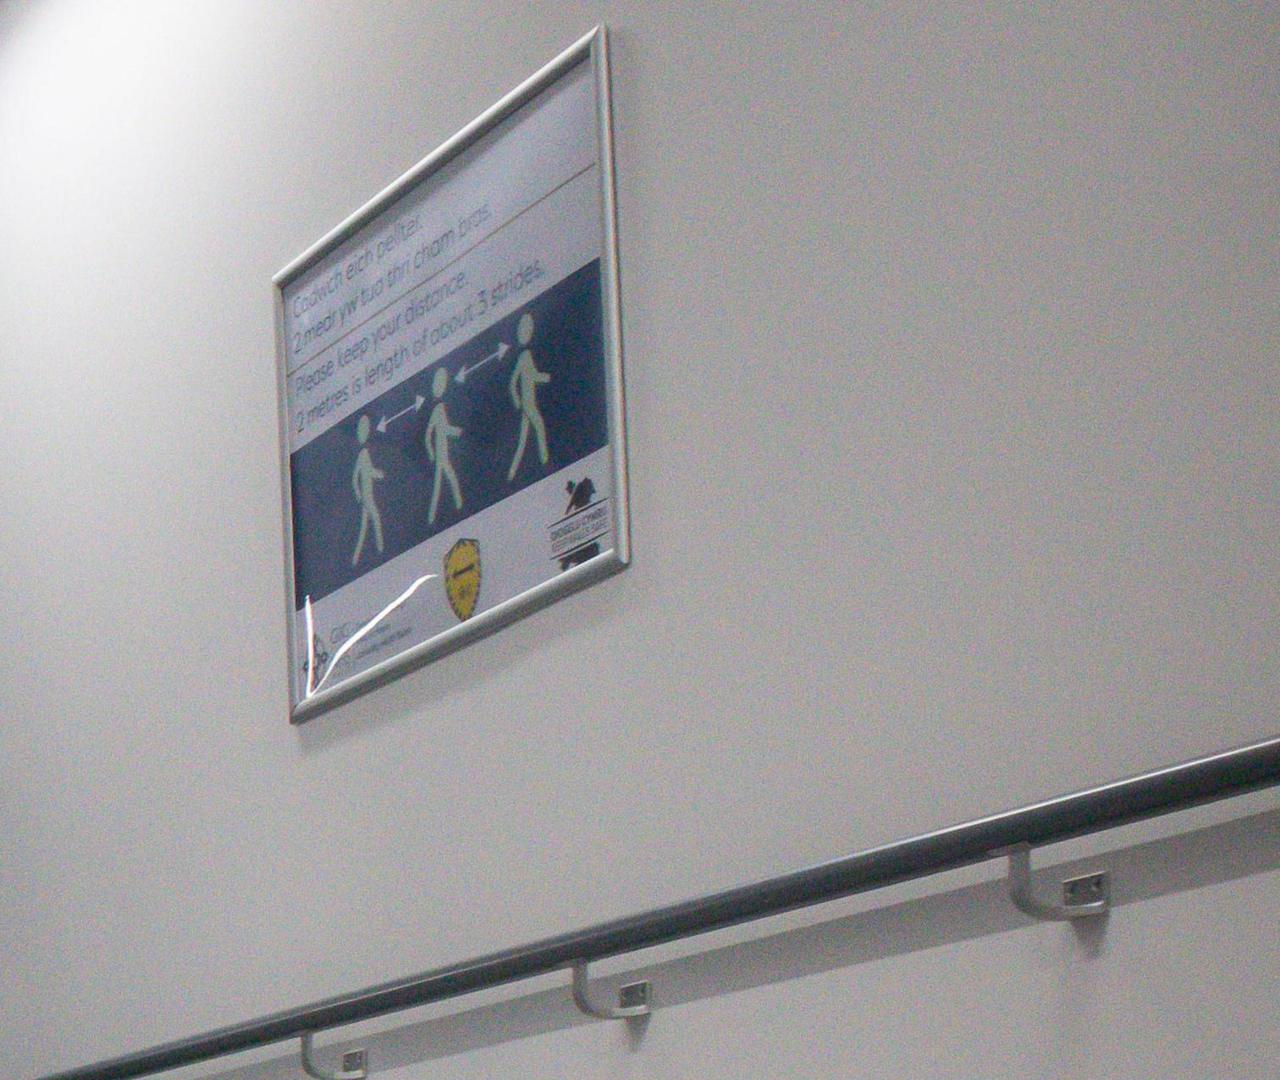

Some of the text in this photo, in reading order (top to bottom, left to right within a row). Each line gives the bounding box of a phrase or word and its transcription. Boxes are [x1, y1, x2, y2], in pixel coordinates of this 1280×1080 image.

[345, 246, 373, 279] eich
[292, 333, 302, 352] 2
[339, 296, 358, 323] yw
[295, 359, 335, 395] Please
[337, 336, 370, 367] keep
[371, 314, 402, 349] your
[296, 411, 305, 431] 2
[306, 386, 349, 424] metres
[351, 377, 362, 395] is
[364, 343, 409, 386] length
[412, 330, 429, 356] of
[430, 302, 474, 344] about
[476, 290, 488, 315] 3
